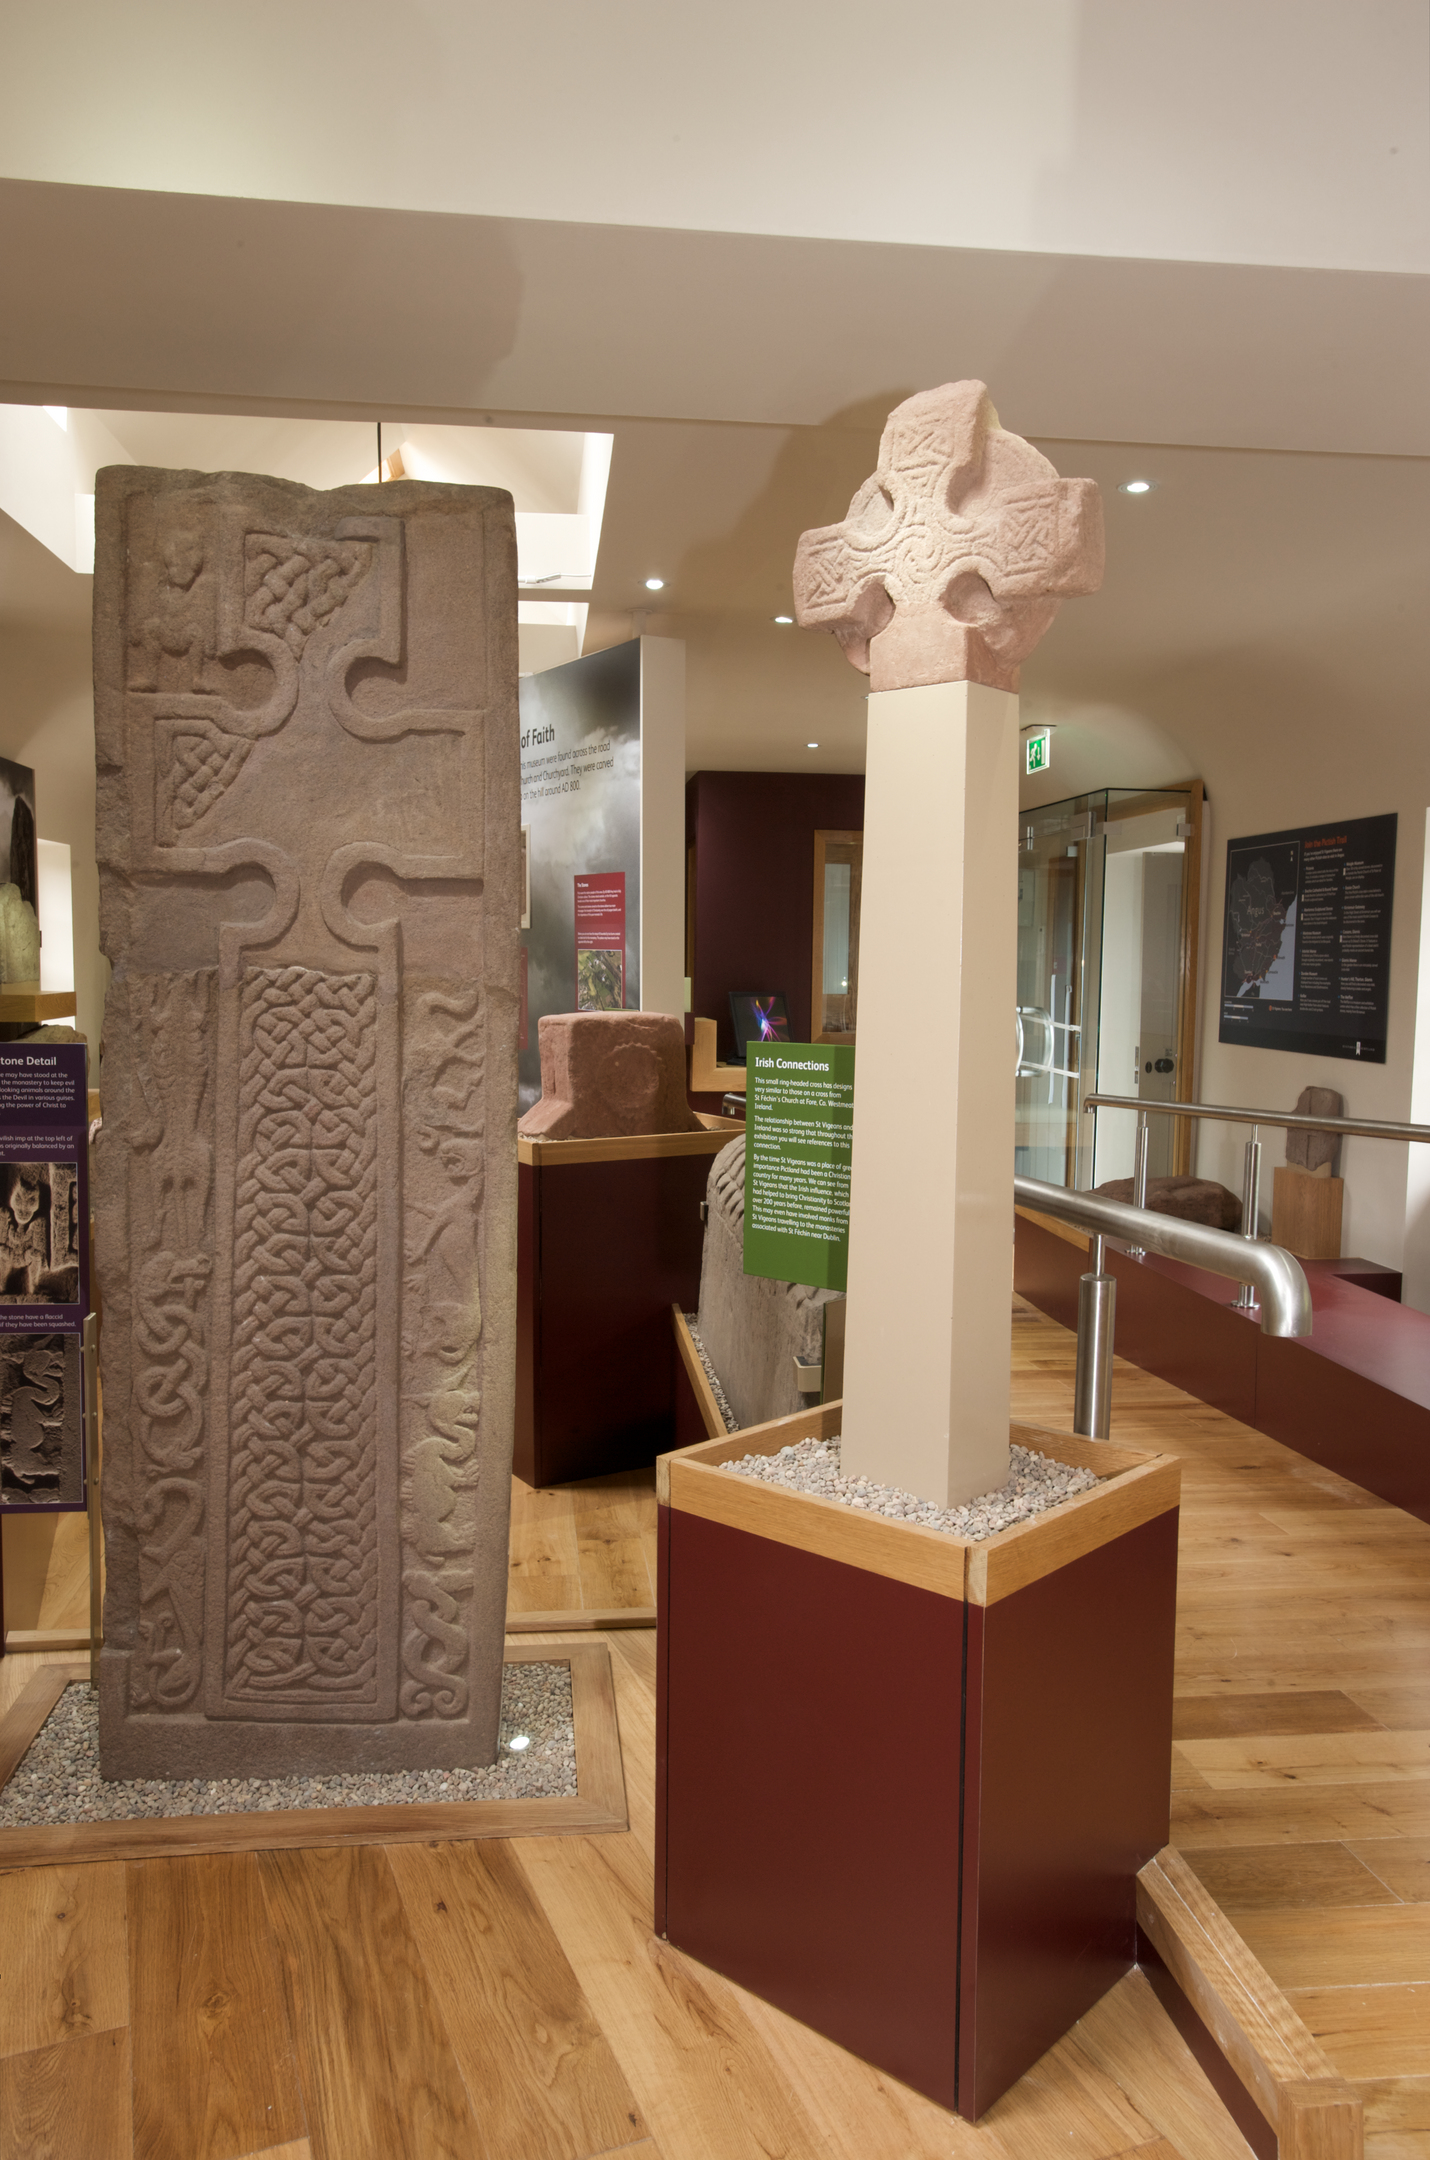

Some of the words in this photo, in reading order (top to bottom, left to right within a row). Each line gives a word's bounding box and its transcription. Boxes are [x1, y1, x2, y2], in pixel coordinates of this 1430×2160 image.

[521, 730, 530, 748] of
[532, 724, 555, 745] Faith
[527, 757, 545, 768] museum
[546, 755, 557, 763] were
[558, 749, 571, 761] found
[572, 747, 588, 758] across
[589, 744, 597, 754] the
[598, 740, 610, 752] road
[521, 774, 532, 784] hurch
[534, 772, 542, 782] and
[543, 766, 570, 780] Churchyard.
[571, 764, 582, 776] They
[583, 763, 595, 772] were
[596, 756, 614, 770] carved
[545, 784, 560, 796] around
[562, 782, 569, 793] AD
[570, 780, 580, 791] 800.
[1247, 907, 1265, 918] Angus
[0, 1057, 24, 1065] tone
[26, 1057, 57, 1065] Detail
[755, 1057, 774, 1068] Irish
[776, 1058, 829, 1071] Connections
[12, 1079, 42, 1087] monastery
[51, 1079, 64, 1087] keep
[780, 1079, 809, 1088] ring-headed
[823, 1081, 832, 1089] has
[833, 1082, 852, 1092] designs
[56, 1094, 75, 1102] guises.
[755, 1087, 765, 1095] very
[755, 1103, 773, 1111] Ireland.
[781, 1096, 799, 1104] Church
[806, 1098, 818, 1107] Fore,
[828, 1100, 854, 1108] Westmeat
[764, 1116, 792, 1127] relationship
[793, 1119, 815, 1127] between
[822, 1121, 842, 1131] Vigeans
[15, 1135, 26, 1143] imp
[45, 1135, 55, 1143] top
[754, 1124, 771, 1132] Ireland
[789, 1127, 805, 1137] strong
[817, 1130, 846, 1140] throughout
[754, 1133, 778, 1141] exhibition
[779, 1136, 788, 1144] you
[807, 1138, 833, 1147] references
[840, 1141, 850, 1149] this
[754, 1142, 781, 1150] connection.
[769, 1155, 780, 1163] time
[787, 1157, 806, 1167] Vigeans
[822, 1161, 835, 1170] place
[753, 1162, 779, 1171] importance
[781, 1165, 799, 1174] Pictland
[800, 1167, 810, 1175] had
[828, 1171, 851, 1180] Christian
[753, 1172, 771, 1181] country
[779, 1175, 793, 1184] many
[759, 1180, 778, 1190] Vigeans
[798, 1185, 809, 1193] Irish
[810, 1187, 833, 1197] influence,
[834, 1190, 849, 1198] which
[763, 1189, 779, 1199] helped
[785, 1192, 798, 1202] bring
[799, 1194, 826, 1206] Christianity
[834, 1198, 850, 1206] Scotla
[764, 1198, 773, 1206] 200
[787, 1201, 803, 1211] before,
[804, 1205, 827, 1213] remained
[828, 1208, 850, 1216] powerful
[753, 1205, 762, 1213] This
[763, 1208, 773, 1216] may
[786, 1210, 798, 1218] have
[799, 1211, 818, 1220] involved
[836, 1217, 848, 1225] from
[758, 1215, 777, 1224] Vigeans
[778, 1217, 799, 1229] travelling
[806, 1221, 814, 1229] the
[815, 1224, 845, 1233] monasteries
[752, 1224, 776, 1232] associated
[777, 1226, 788, 1234] with
[823, 1233, 841, 1241] Dublin.
[5, 1321, 18, 1329] they
[49, 1321, 76, 1329] squashed.
